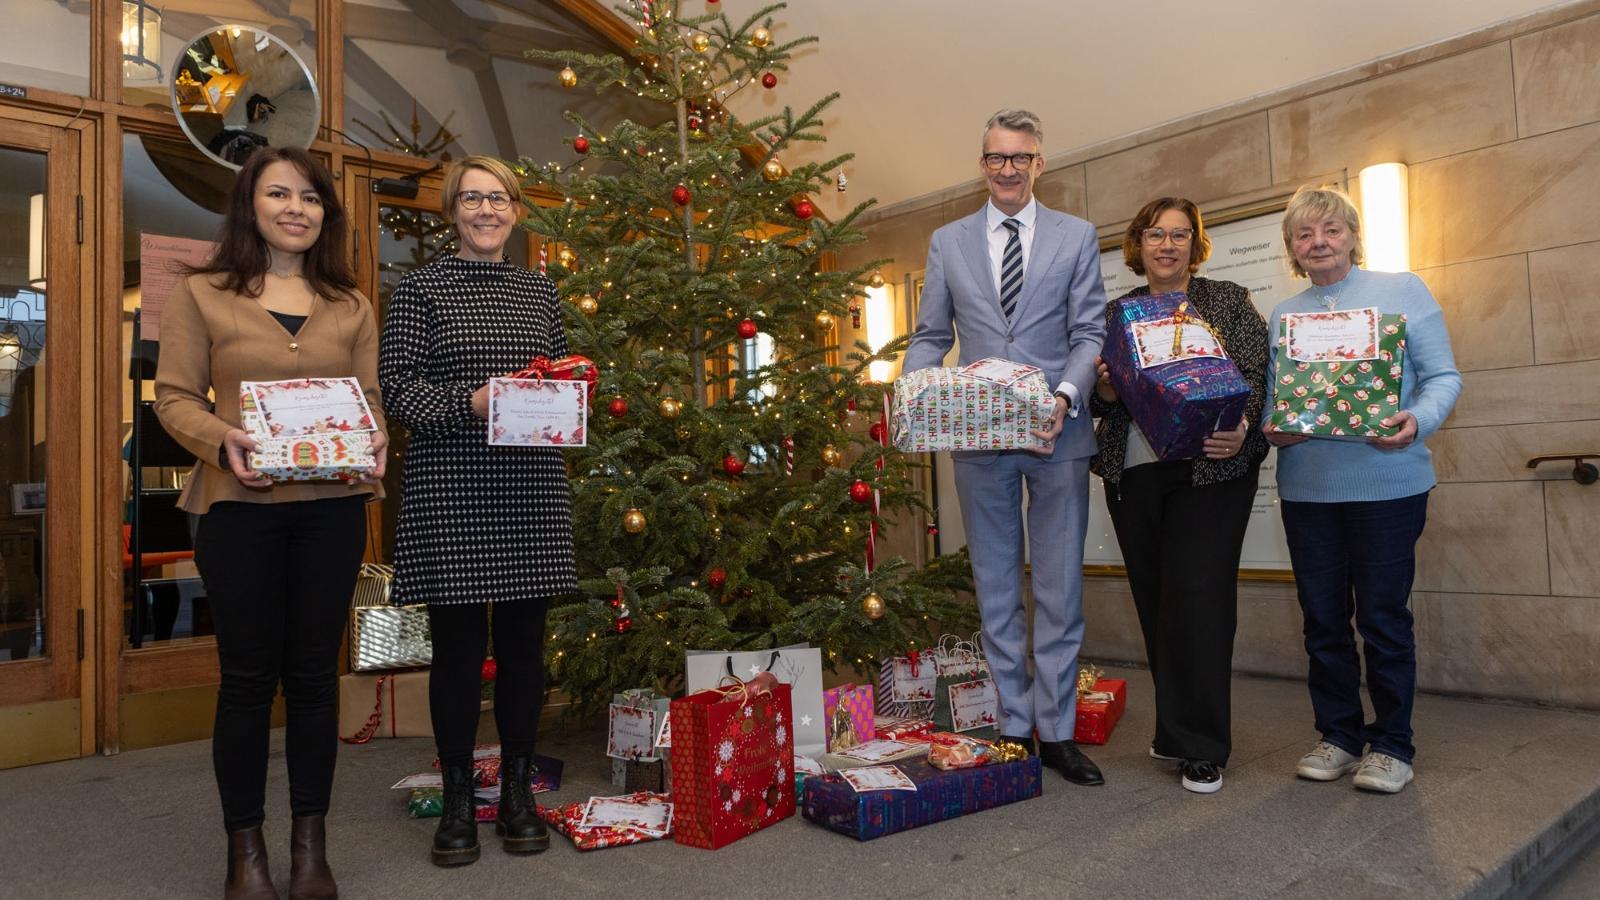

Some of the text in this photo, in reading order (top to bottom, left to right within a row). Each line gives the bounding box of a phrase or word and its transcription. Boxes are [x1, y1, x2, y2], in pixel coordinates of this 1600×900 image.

[1229, 241, 1271, 256] Wegweiser
[979, 383, 989, 412] MERRY
[991, 383, 1001, 432] CHRISTMAS
[1004, 397, 1015, 423] MERRY
[927, 396, 938, 443] CHRISTMAS
[940, 409, 951, 434] MERRY
[953, 409, 963, 450] HRISTMAS
[966, 421, 977, 447] MERRY
